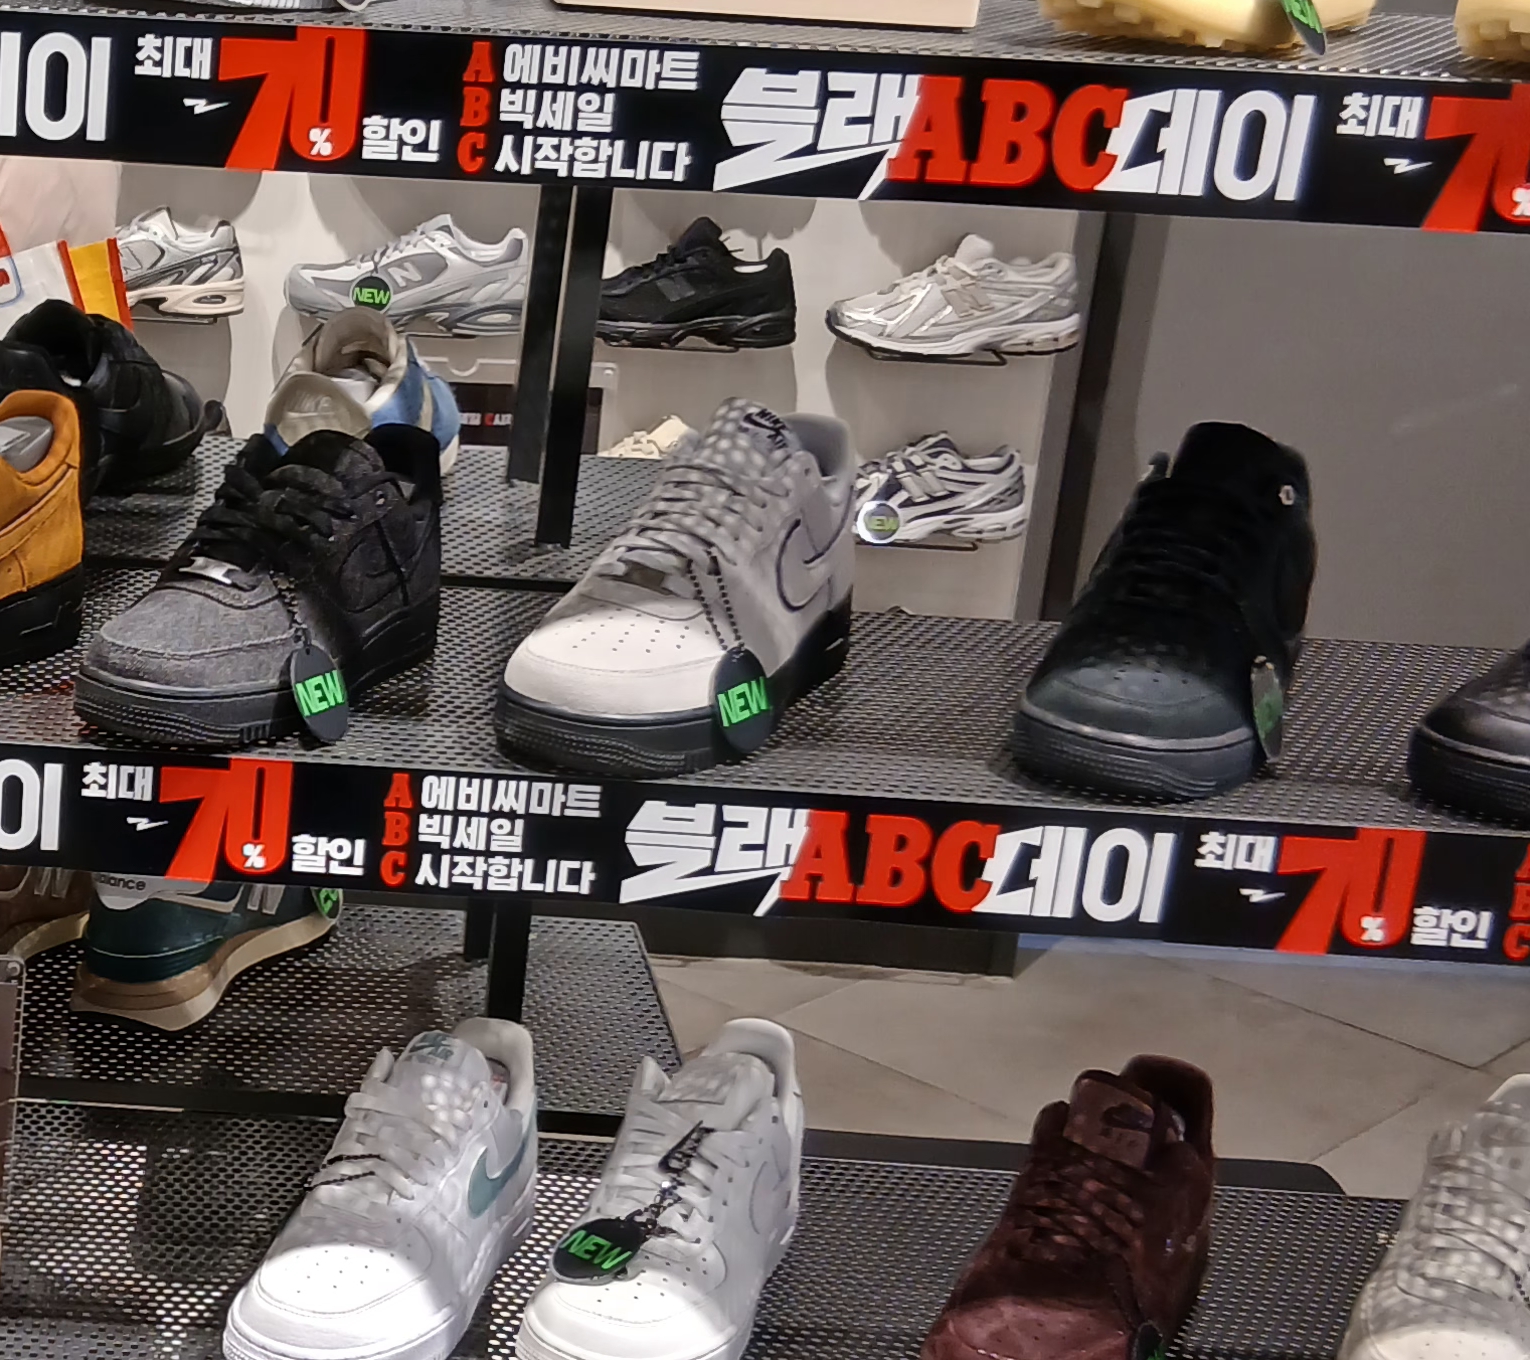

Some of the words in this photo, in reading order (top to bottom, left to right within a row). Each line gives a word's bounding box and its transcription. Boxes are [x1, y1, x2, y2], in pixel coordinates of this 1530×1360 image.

[463, 42, 495, 83] A
[502, 43, 701, 91] 에비씨마트
[134, 33, 213, 80] 최대
[362, 115, 440, 163] 할인
[460, 87, 490, 128] B
[499, 90, 616, 133] 빅세일
[1336, 92, 1424, 139] 최대
[457, 132, 486, 174] C
[494, 138, 694, 182] 시작합니다
[354, 288, 389, 304] NEW
[294, 670, 344, 718] NEW
[718, 677, 769, 727] NEW
[80, 761, 154, 802] 최대
[291, 833, 366, 877] 할인
[383, 772, 413, 809] A
[420, 774, 603, 819] 에비씨마트
[381, 812, 410, 847] B
[418, 813, 525, 853] 빅세일
[380, 850, 407, 887] C
[414, 854, 598, 897] 시작합니다
[1194, 830, 1278, 874] 최대
[1411, 905, 1494, 949] 할인
[563, 1228, 633, 1272] NEW
